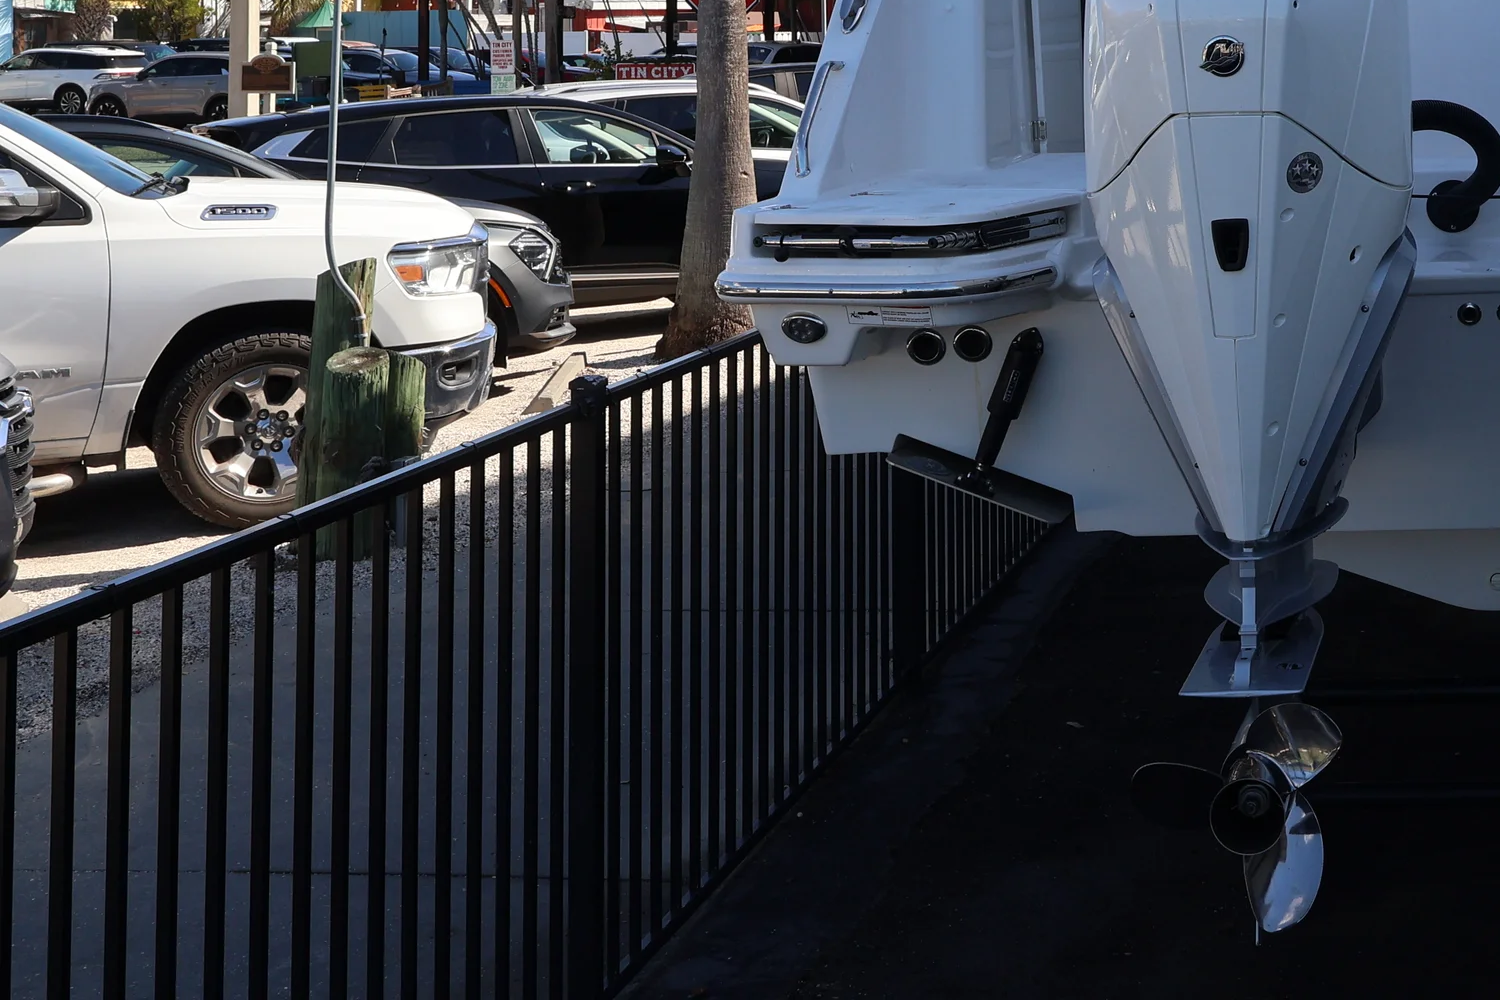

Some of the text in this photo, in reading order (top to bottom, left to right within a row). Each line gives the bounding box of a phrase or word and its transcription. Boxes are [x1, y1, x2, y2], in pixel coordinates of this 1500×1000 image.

[619, 66, 692, 79] TIN CITY
[208, 206, 268, 215] 1500
[14, 367, 72, 381] AM
